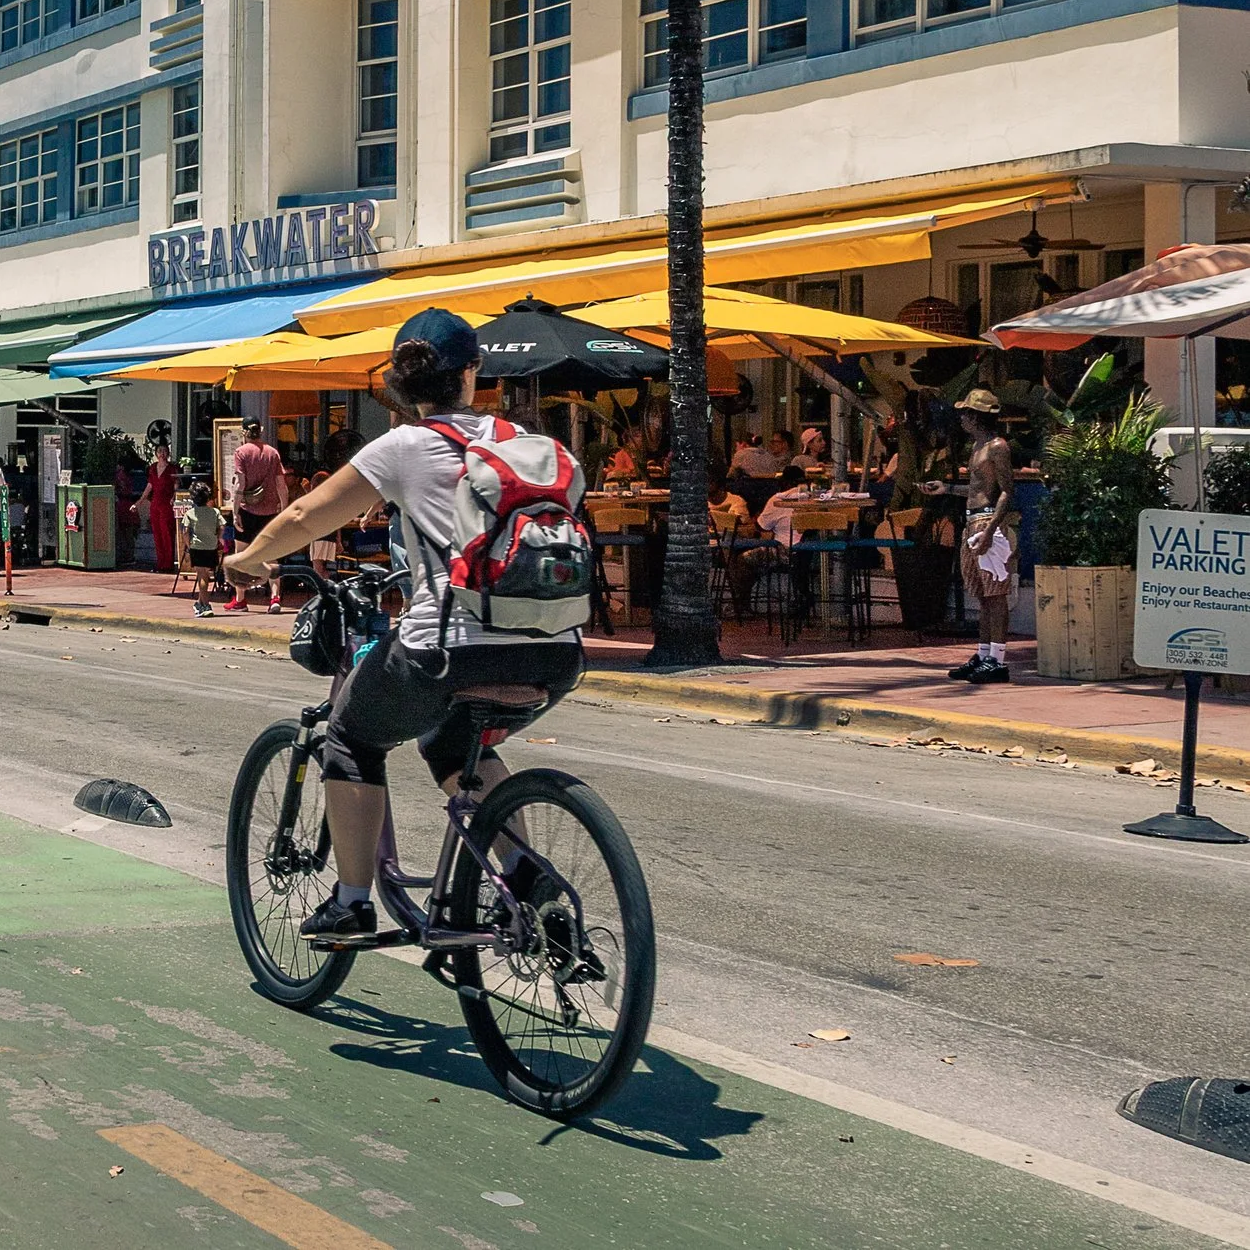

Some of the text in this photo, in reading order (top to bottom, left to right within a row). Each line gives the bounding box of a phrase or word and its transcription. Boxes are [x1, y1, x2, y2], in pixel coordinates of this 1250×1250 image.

[148, 199, 380, 287] BREAKWATER
[479, 343, 537, 352] ALET
[1149, 525, 1250, 557] VALET
[1152, 553, 1246, 575] PARKING
[1142, 581, 1177, 597] Enjoy
[1179, 587, 1200, 596] our
[1142, 595, 1171, 609] Enjoy
